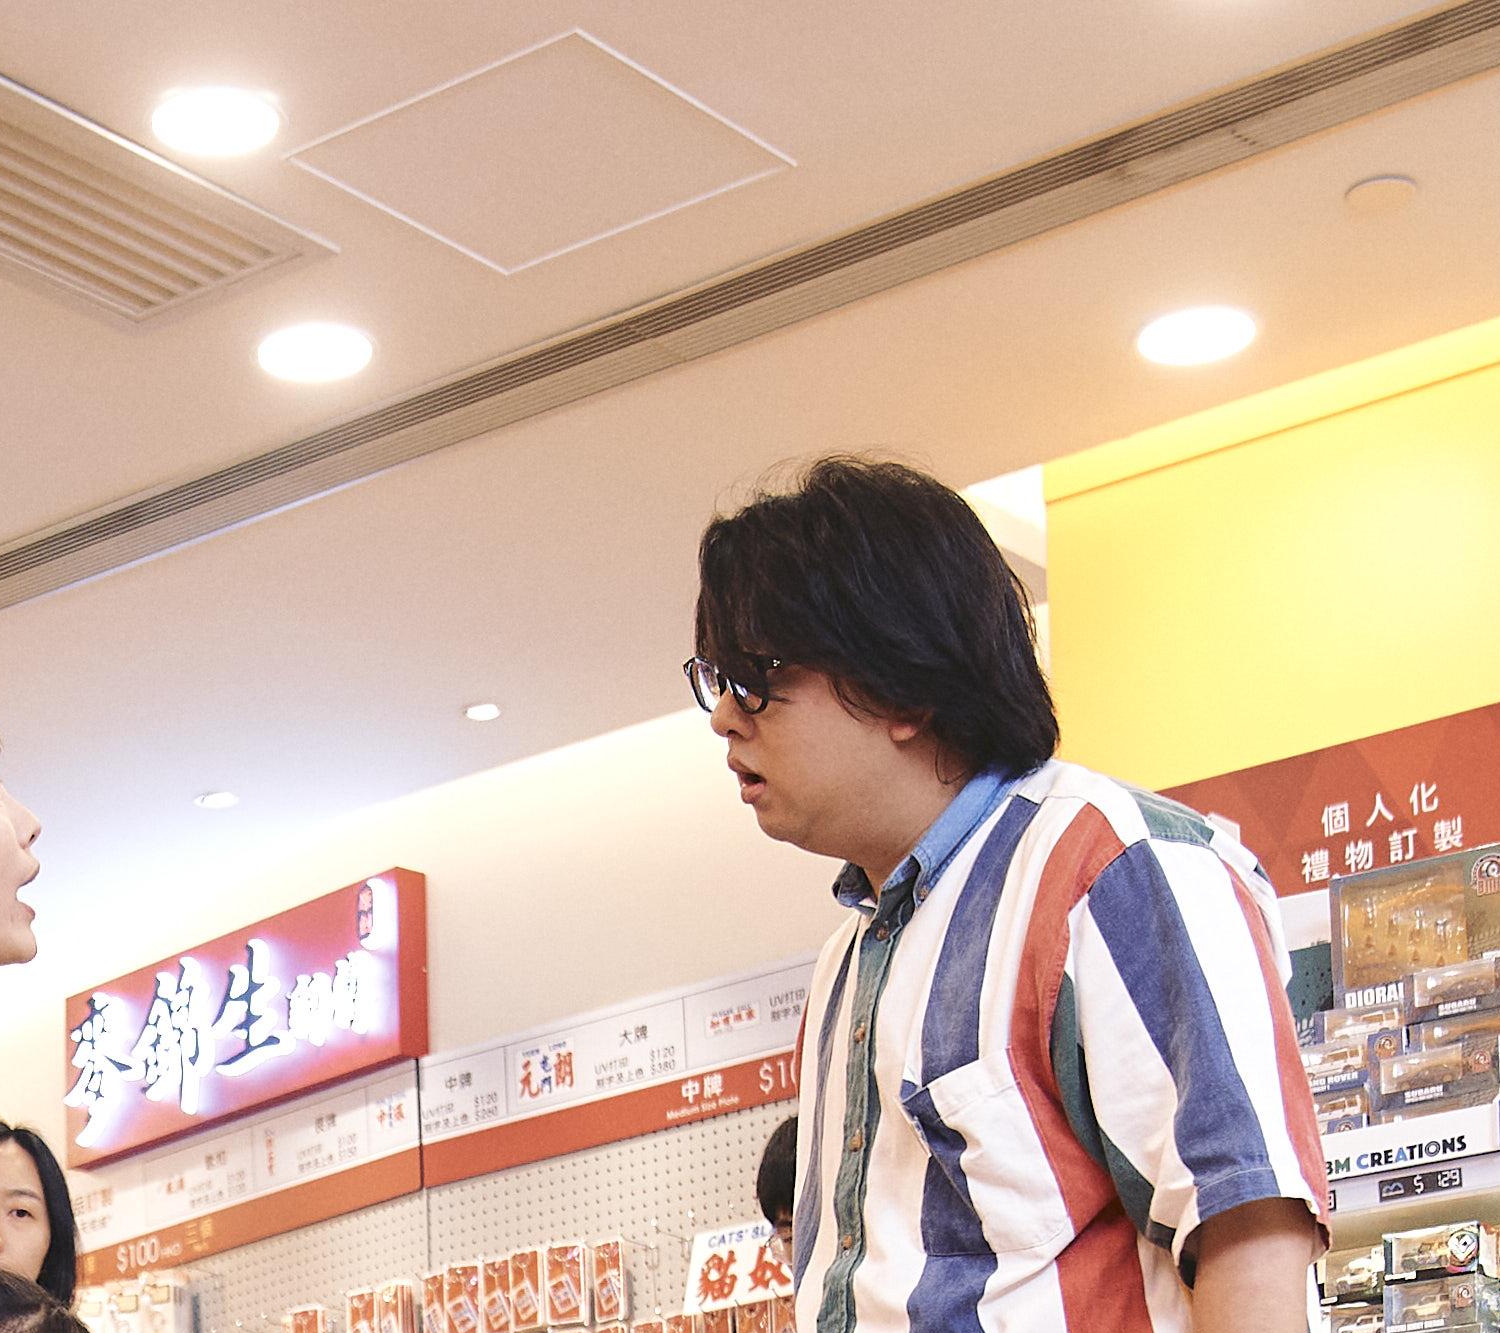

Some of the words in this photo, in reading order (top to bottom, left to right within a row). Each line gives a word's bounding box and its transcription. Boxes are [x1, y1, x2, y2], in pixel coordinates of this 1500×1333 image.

[1321, 782, 1438, 838] 個人化
[1301, 816, 1463, 884] 禮物訂製
[1345, 982, 1404, 1009] DIORA
[619, 1025, 648, 1047] 大牌
[650, 1046, 675, 1062] $120
[519, 1051, 574, 1098] 元朗
[681, 1072, 724, 1104] 中牌
[1357, 1135, 1467, 1169] CREATIONS
[1413, 1174, 1424, 1194] $
[1438, 1168, 1460, 1188] 129
[708, 1229, 749, 1248] CATS'
[116, 1237, 159, 1273] $100
